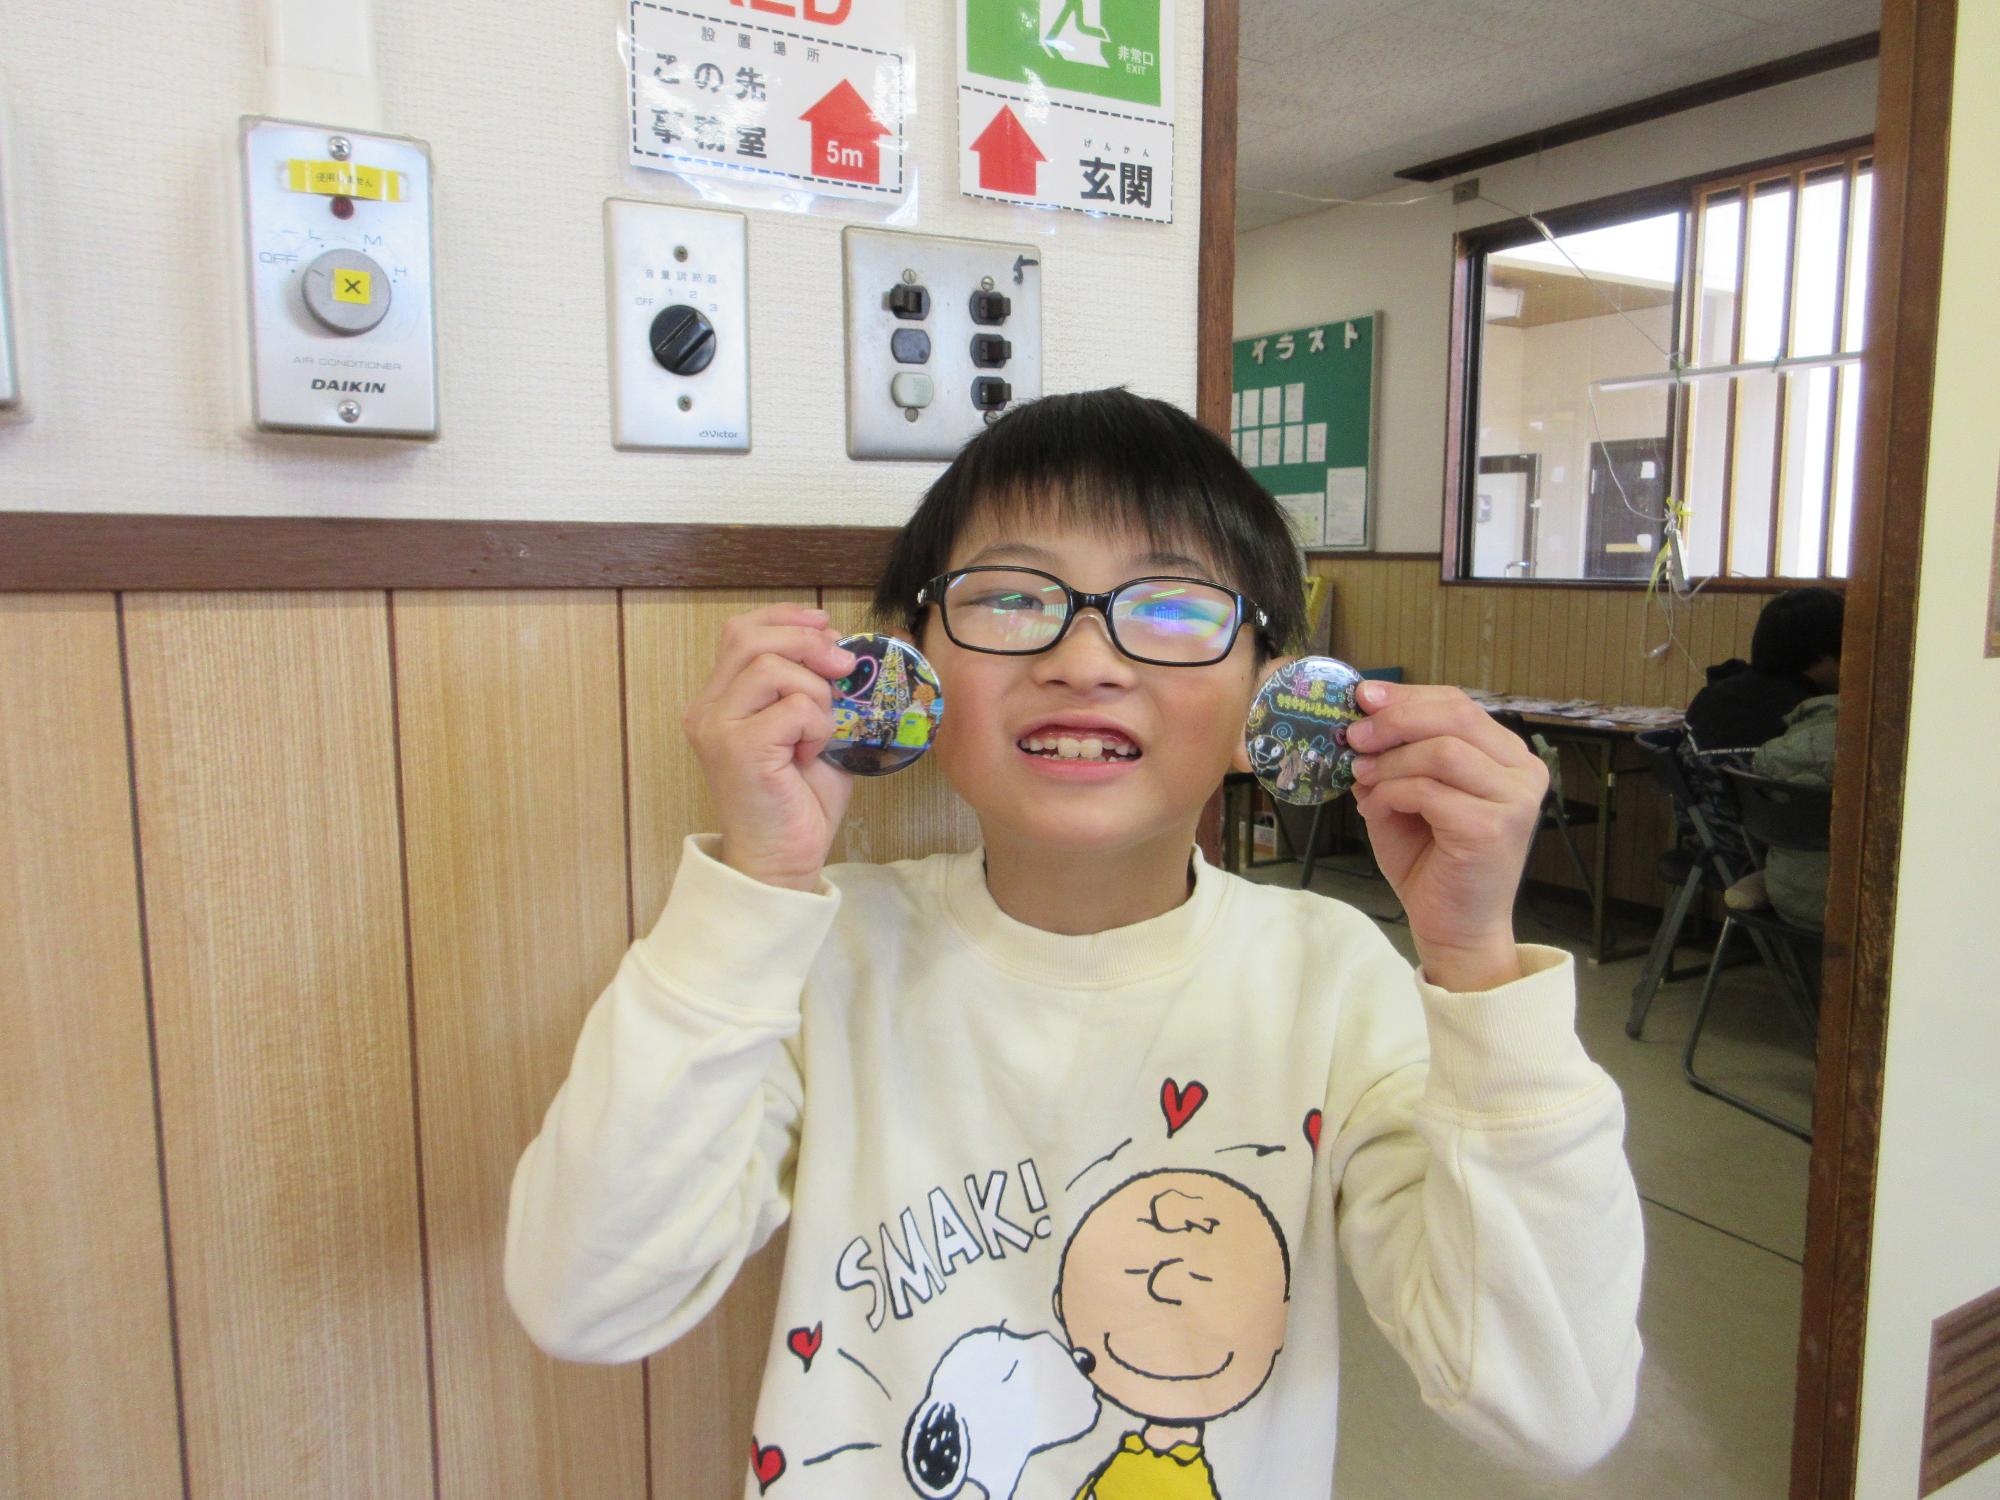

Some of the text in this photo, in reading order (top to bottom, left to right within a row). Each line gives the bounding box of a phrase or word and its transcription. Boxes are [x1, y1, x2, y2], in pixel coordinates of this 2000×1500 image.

[701, 26, 821, 64] 設置場所
[1117, 45, 1154, 66] 非常口
[653, 52, 767, 102] この先
[1125, 63, 1147, 75] EXIT
[826, 141, 863, 168] 5m
[1083, 138, 1150, 158] げんかん
[1079, 156, 1153, 209] 玄関
[364, 233, 382, 247] M
[259, 251, 298, 265] OFF
[635, 296, 654, 306] OFF
[1252, 320, 1360, 365] イラスト
[293, 356, 402, 370] AIR CONDITIONER
[310, 378, 387, 394] DAIKIN
[708, 430, 738, 439] Victor
[836, 1157, 1052, 1333] SMAK!
